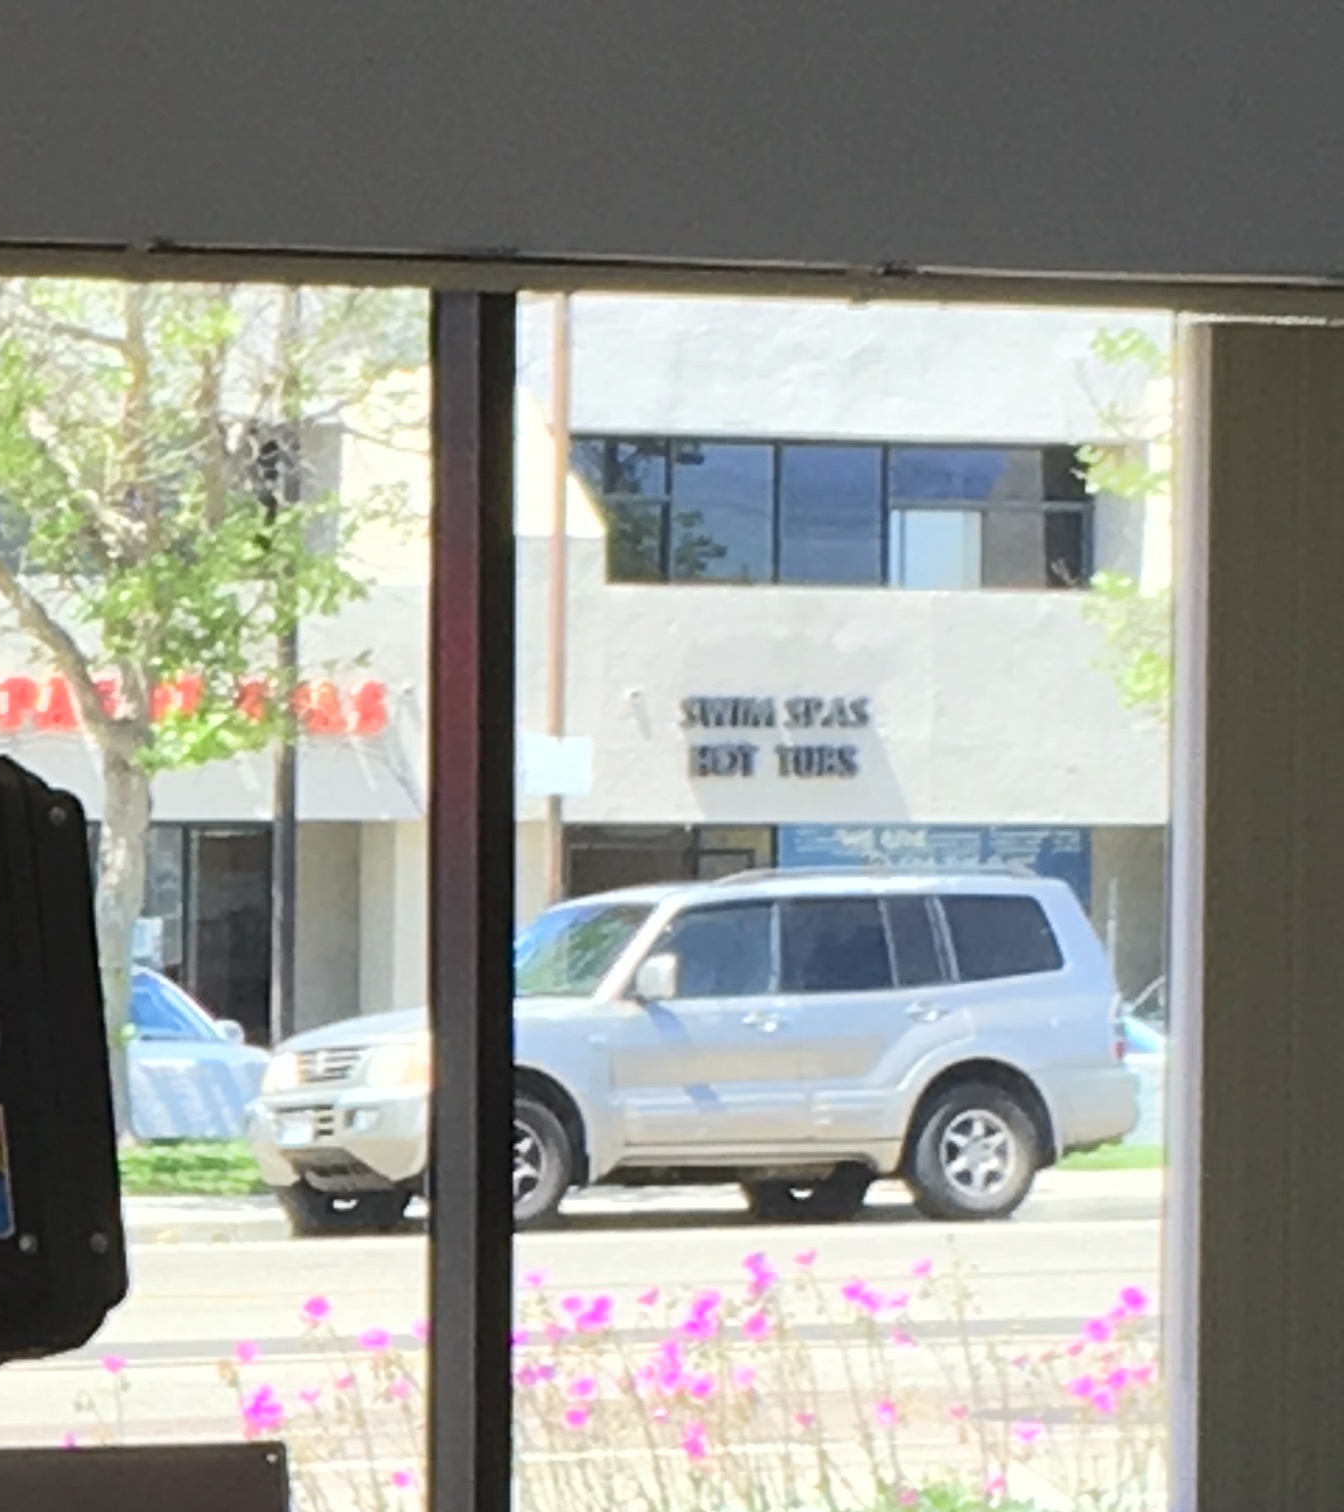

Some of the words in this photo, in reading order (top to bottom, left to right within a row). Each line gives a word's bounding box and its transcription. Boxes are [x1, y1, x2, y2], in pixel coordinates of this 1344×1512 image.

[679, 696, 777, 729] SWIM
[783, 696, 871, 729] SPAS
[688, 744, 759, 778] HOT
[774, 744, 860, 778] TUBS
